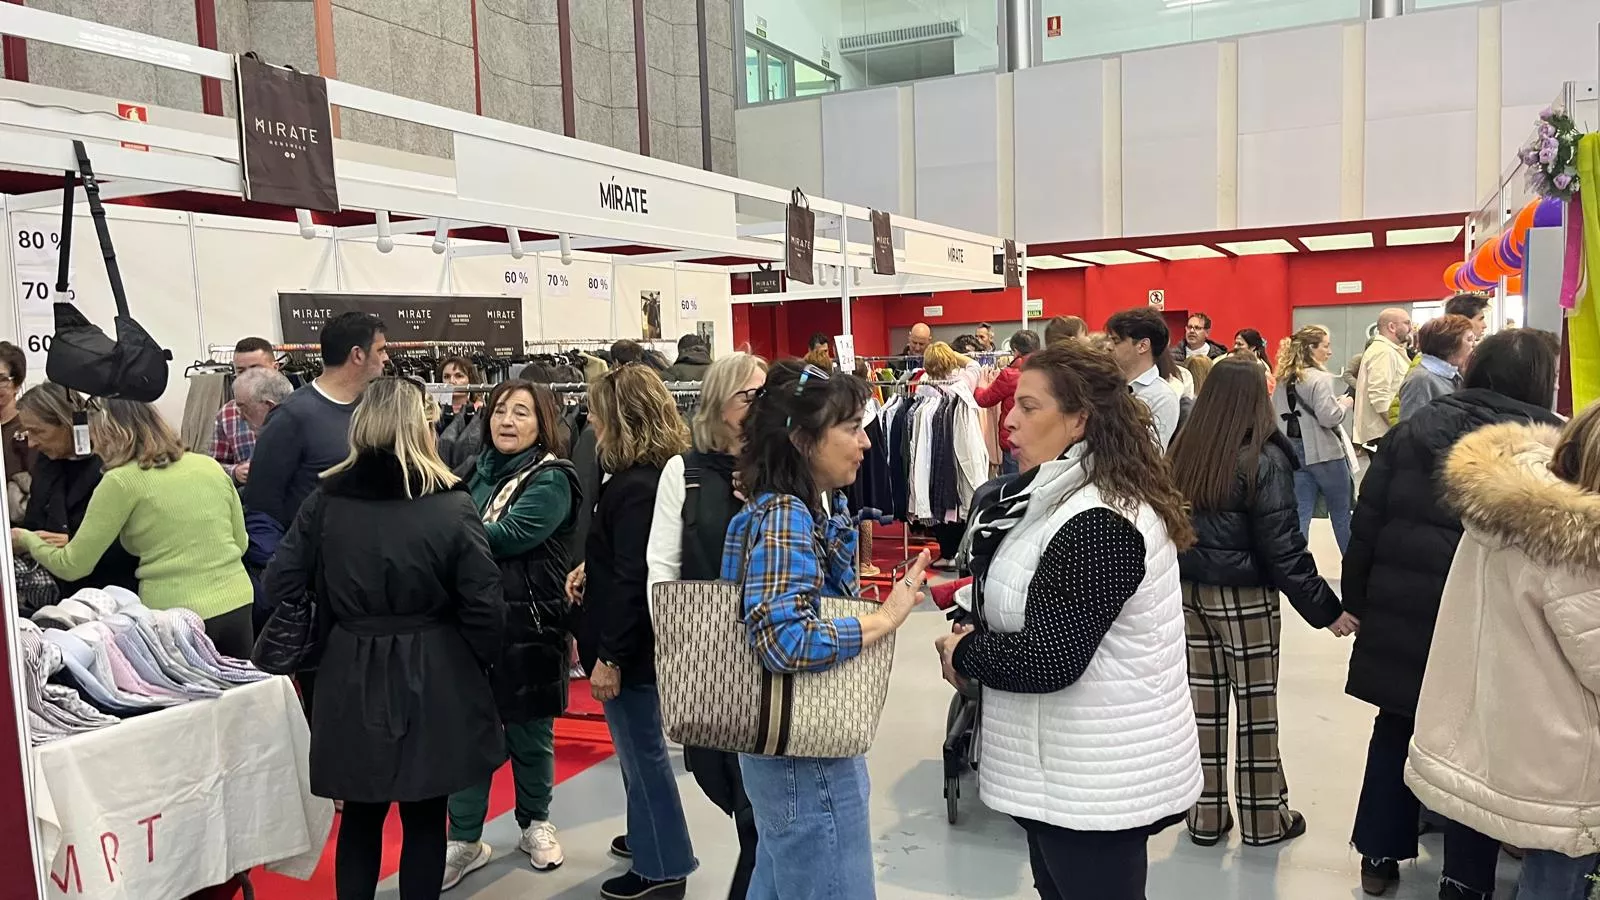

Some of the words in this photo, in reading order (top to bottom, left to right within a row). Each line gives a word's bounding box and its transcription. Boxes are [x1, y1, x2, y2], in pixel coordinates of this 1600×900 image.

[254, 117, 318, 144] MIRATE
[599, 175, 648, 214] MÍRATE
[18, 230, 45, 249] 80
[504, 271, 517, 284] 60
[518, 271, 528, 284] %
[547, 274, 559, 287] 70
[560, 275, 569, 287] %
[588, 278, 599, 289] 80
[600, 278, 608, 290] %
[22, 282, 49, 300] 70
[681, 299, 690, 310] 60
[690, 299, 698, 310] %
[292, 309, 332, 318] MIRATE
[398, 309, 432, 319] MIRATE
[486, 310, 516, 319] MIRATE
